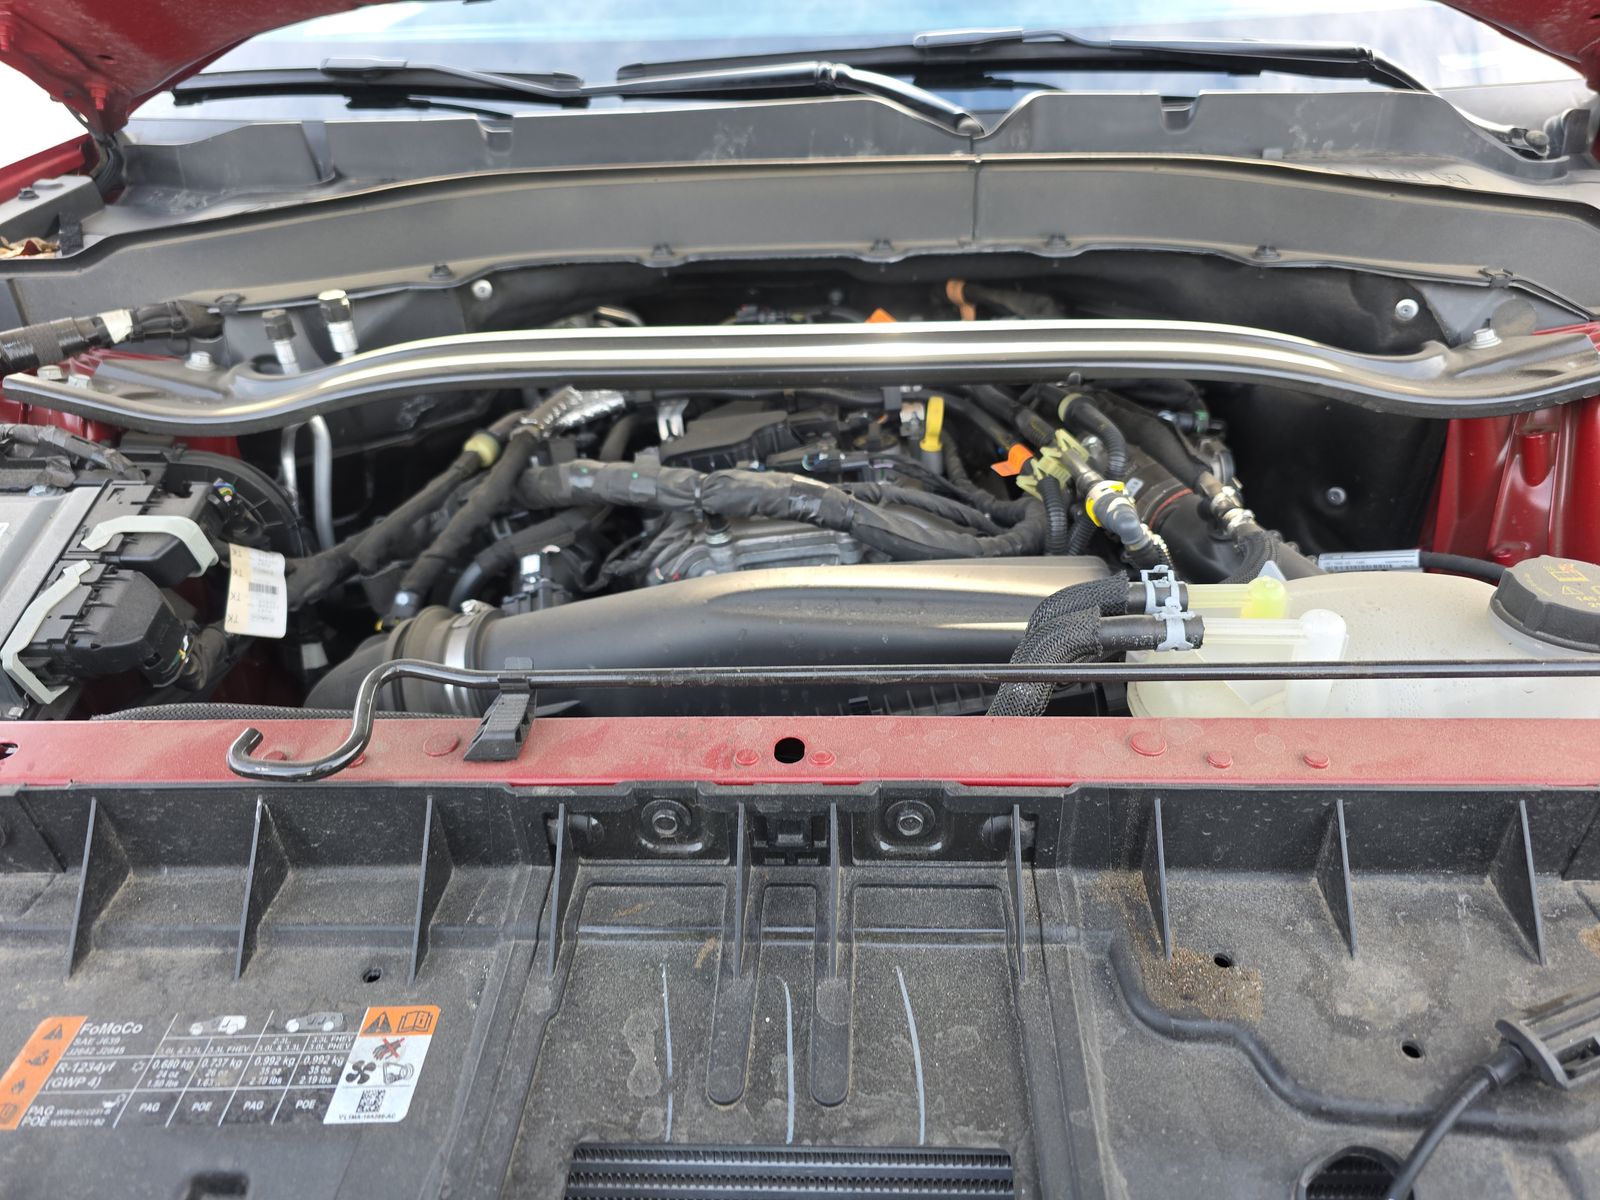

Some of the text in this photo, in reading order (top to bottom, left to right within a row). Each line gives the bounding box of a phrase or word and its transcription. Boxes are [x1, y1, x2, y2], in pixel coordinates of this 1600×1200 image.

[80, 1022, 144, 1035] FoMoCo
[74, 1037, 95, 1046] SAE
[181, 1059, 194, 1070] kg
[201, 1058, 242, 1070] 0.737 kg
[254, 1056, 296, 1067] 0.992 kg
[304, 1054, 345, 1067] 0.992 kg
[56, 1060, 117, 1074] R-1234yf
[260, 1068, 270, 1076] 35
[308, 1066, 319, 1074] 35
[45, 1076, 102, 1090] (GWP 4)
[269, 1076, 282, 1084] lbs
[299, 1076, 332, 1084] 2.19 lbs
[138, 1102, 160, 1112] PAG
[192, 1102, 213, 1112] POE
[243, 1100, 264, 1110] PAG
[296, 1100, 316, 1110] POE
[27, 1105, 55, 1116] PAG
[21, 1116, 50, 1127] POE
